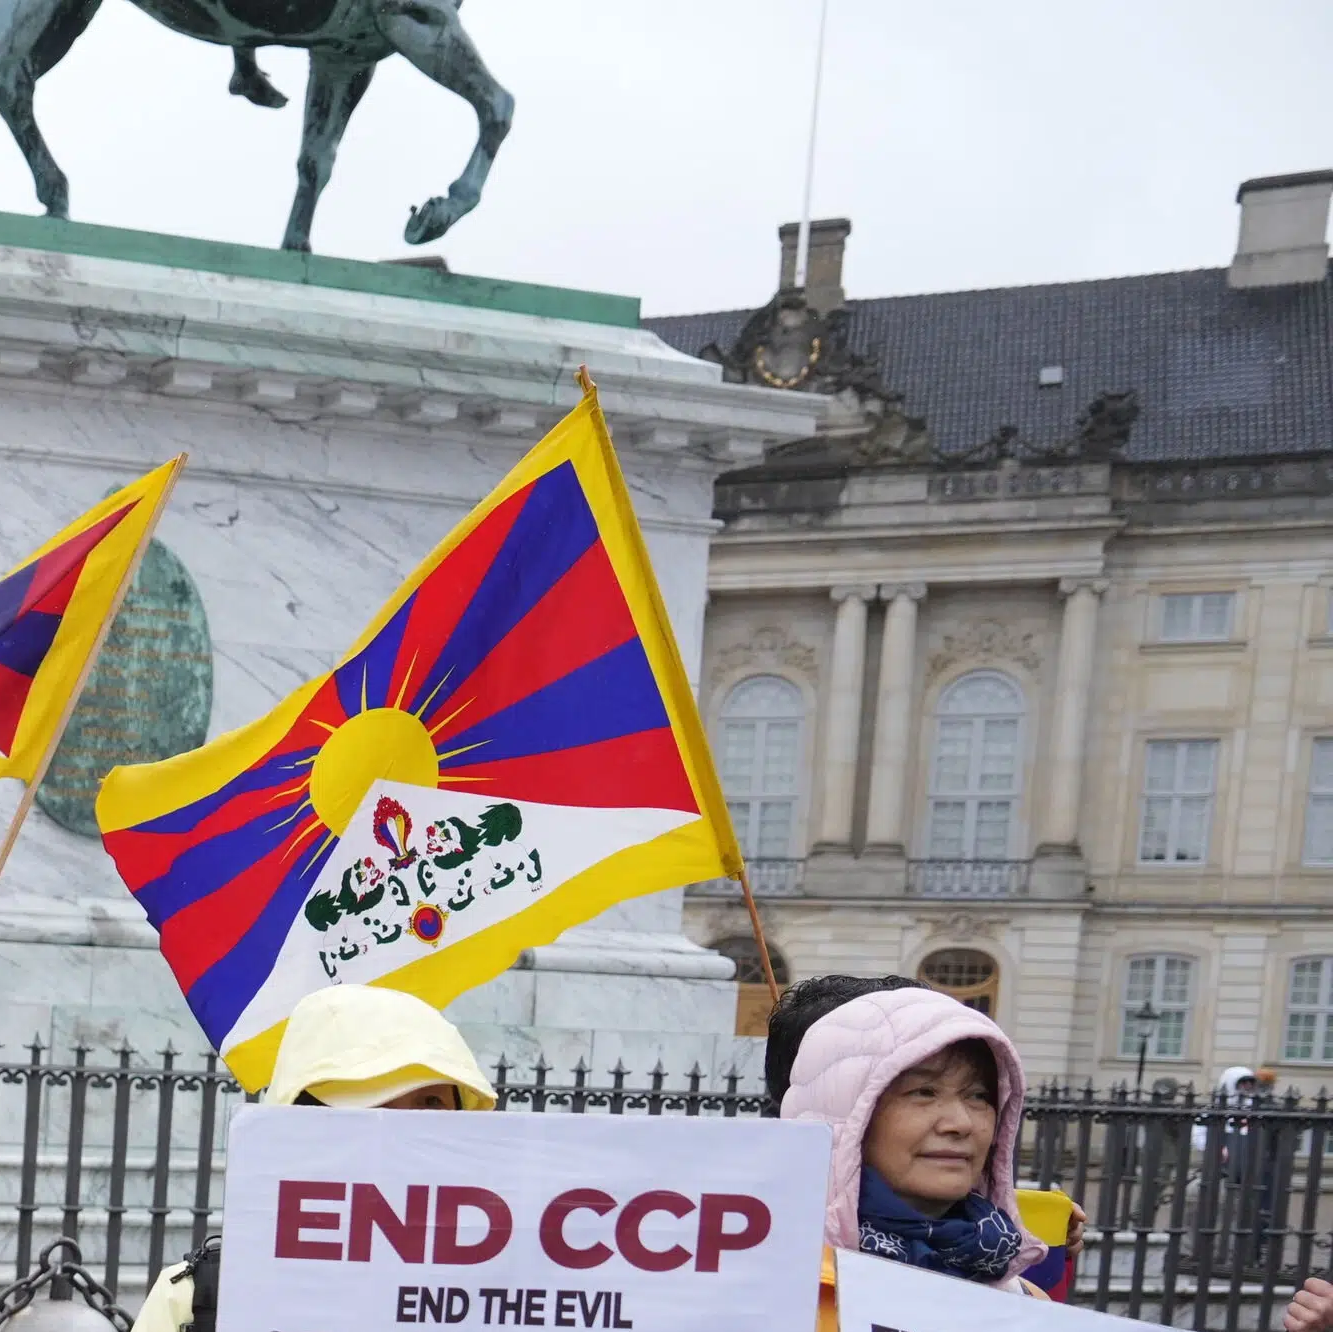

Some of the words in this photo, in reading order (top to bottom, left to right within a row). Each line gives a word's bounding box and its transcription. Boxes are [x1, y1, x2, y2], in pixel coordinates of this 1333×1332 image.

[275, 1180, 513, 1265] END
[538, 1188, 772, 1273] CCP
[396, 1285, 470, 1324] END
[478, 1287, 547, 1327] THE
[554, 1289, 633, 1330] EVIL
